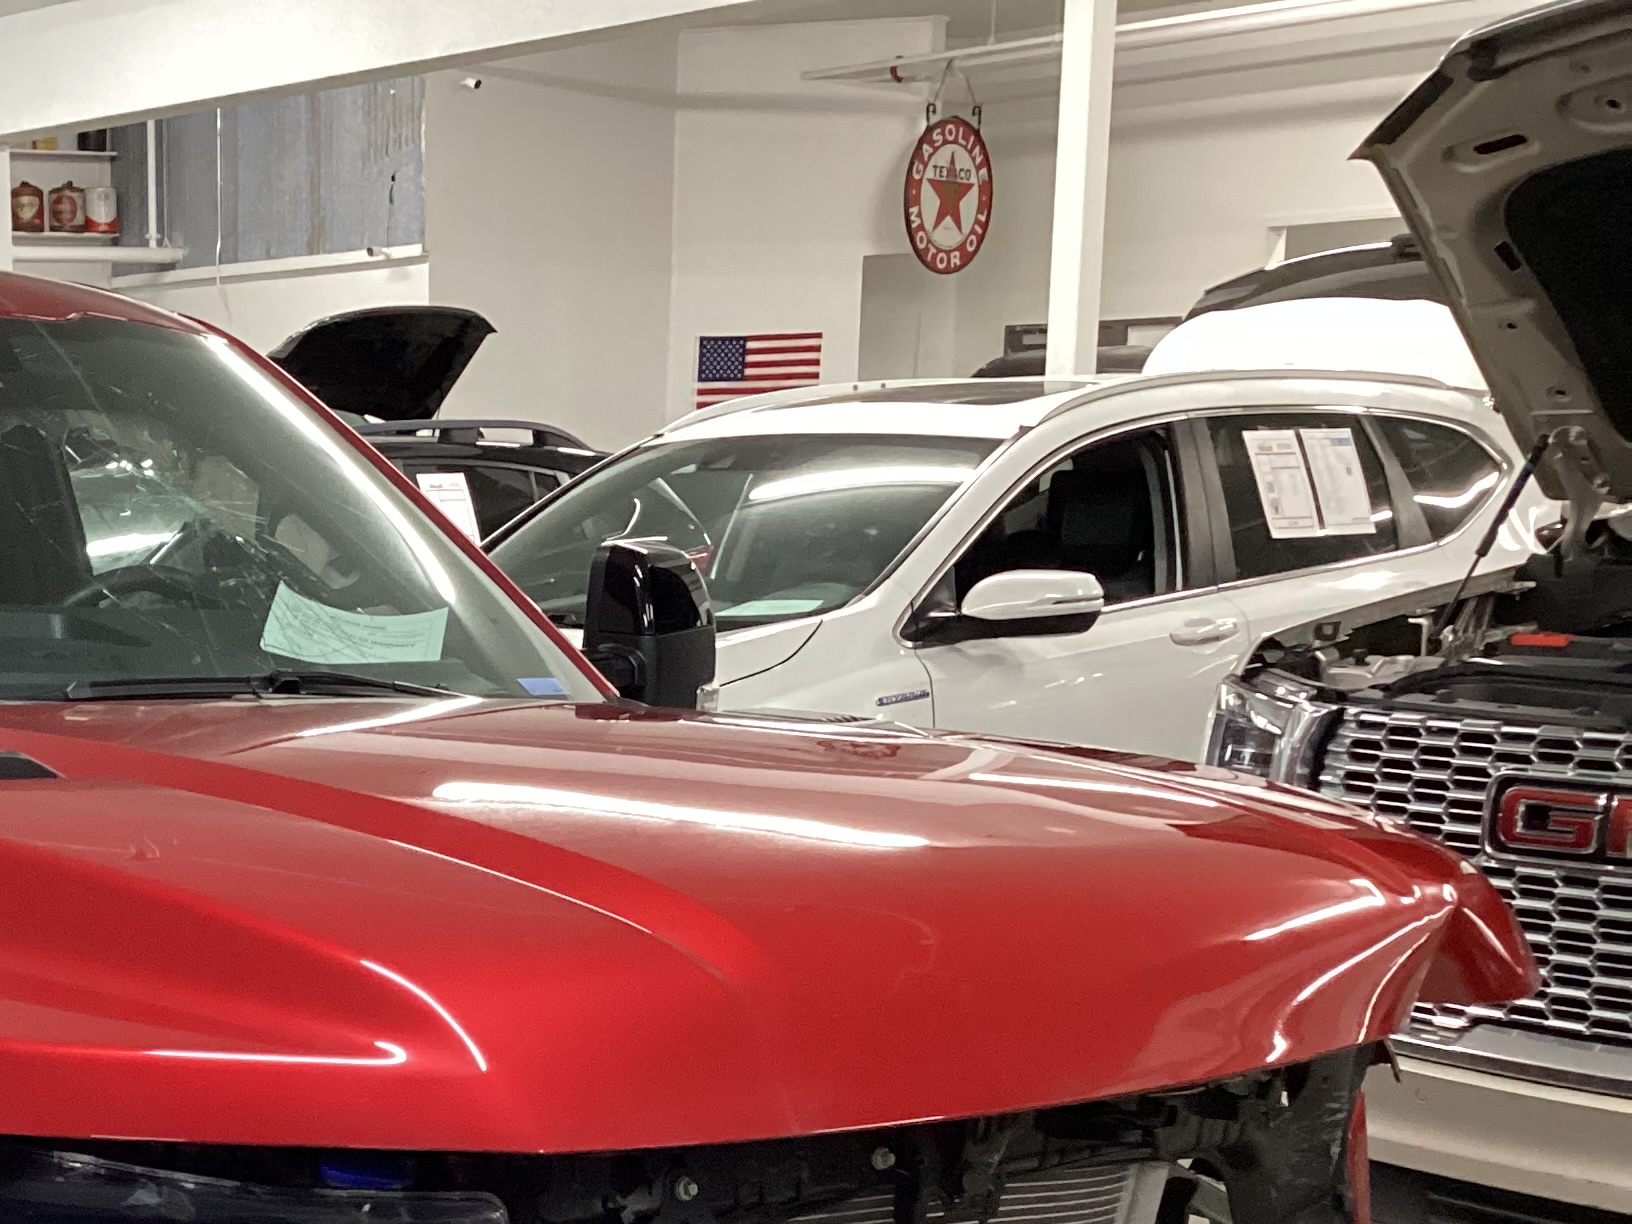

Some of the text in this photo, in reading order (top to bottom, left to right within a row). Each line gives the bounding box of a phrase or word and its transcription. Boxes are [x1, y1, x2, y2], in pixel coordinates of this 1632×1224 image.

[912, 124, 989, 185] GASOLINE
[908, 204, 988, 269] MOTOR OIL
[1498, 785, 1632, 858] G
